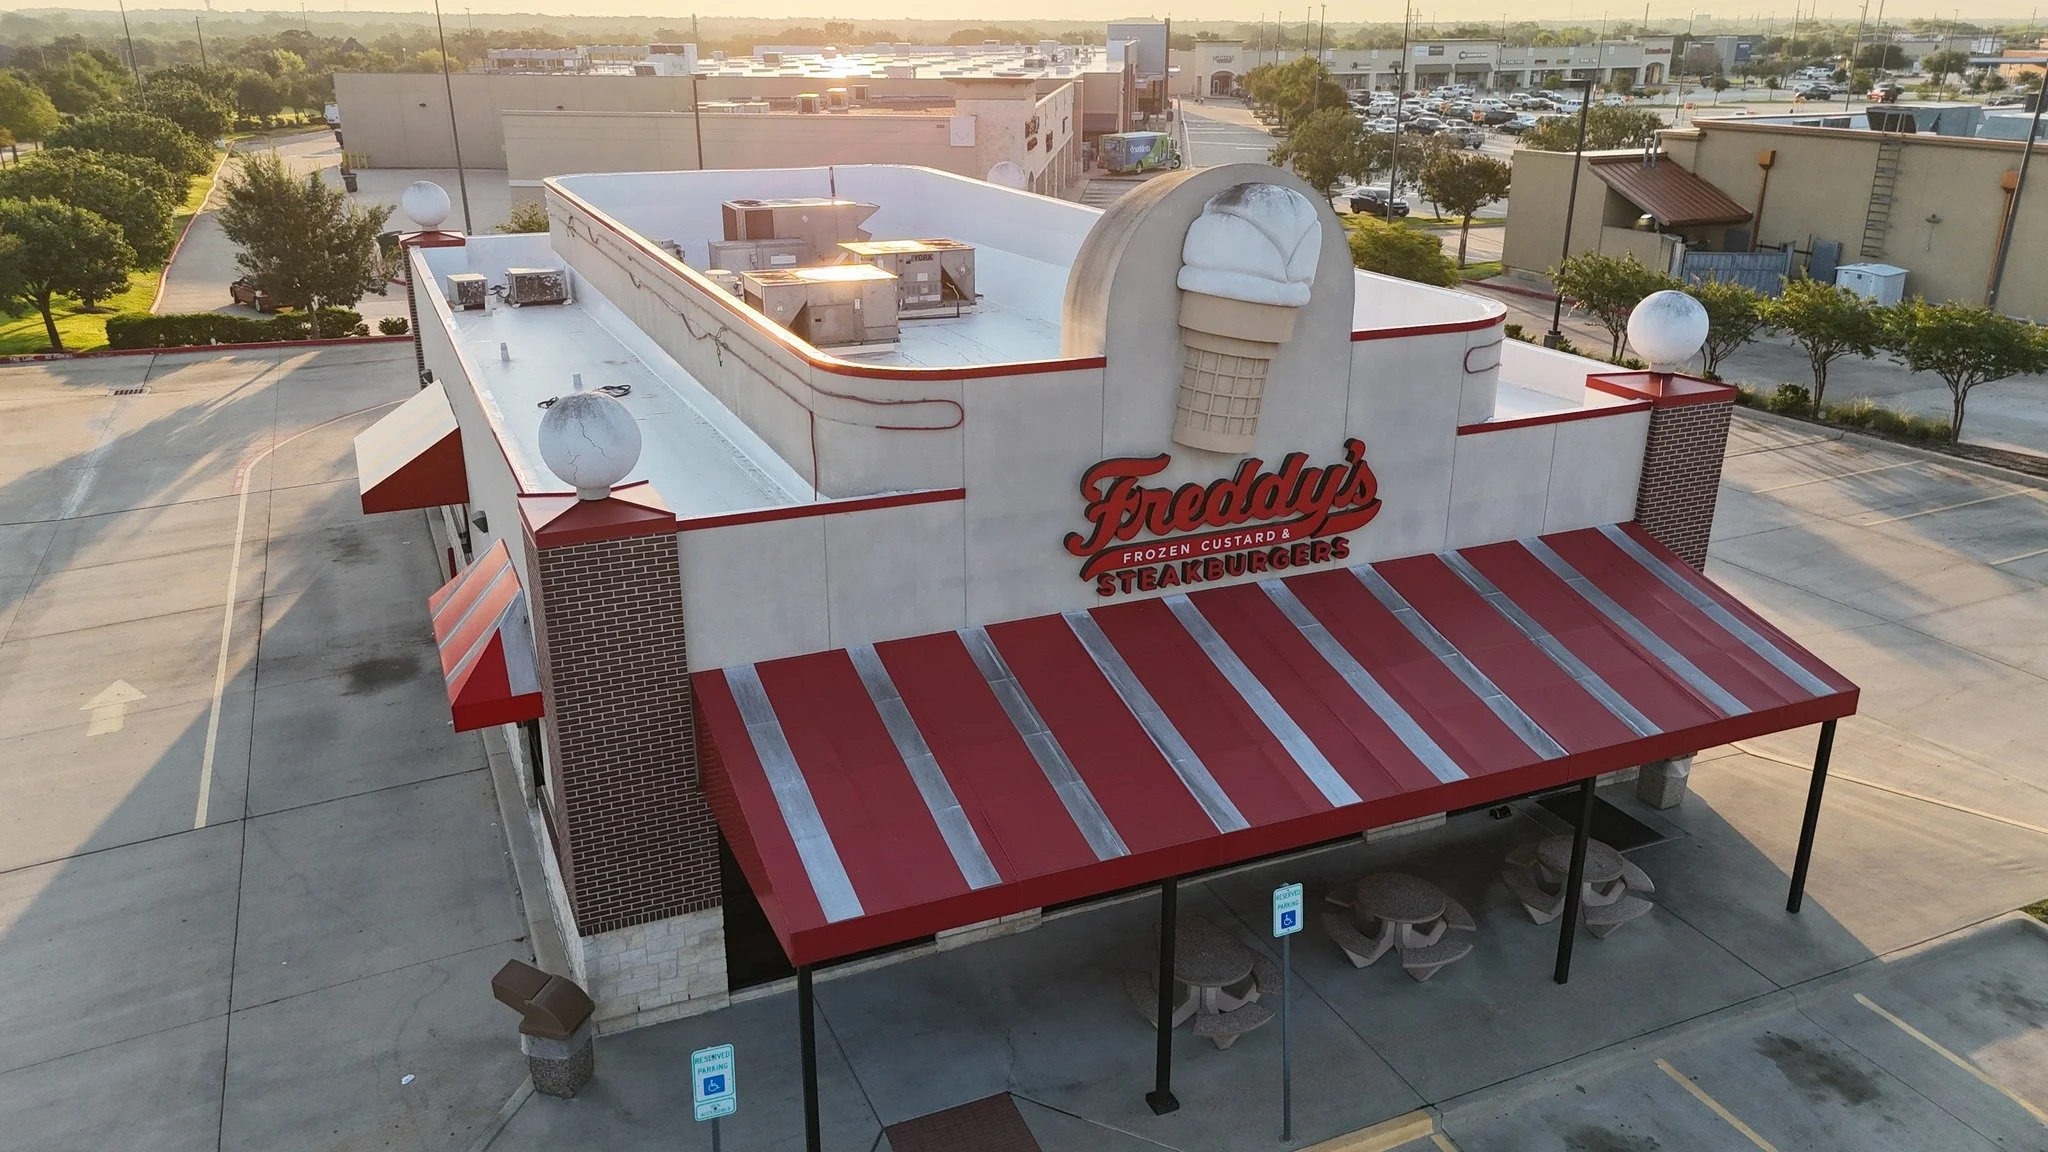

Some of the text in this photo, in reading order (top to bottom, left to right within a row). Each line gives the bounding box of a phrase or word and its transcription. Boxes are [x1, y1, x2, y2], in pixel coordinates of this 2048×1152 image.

[913, 253, 934, 262] YORK
[1063, 437, 1381, 567] Freddy's
[1123, 528, 1291, 564] FROZEN CUSTARD &
[1095, 536, 1350, 597] STEAKBURGERS
[1276, 889, 1301, 900] RESERVED
[1277, 900, 1300, 911] PARKING
[694, 1051, 731, 1065] RESERVED
[697, 1062, 728, 1075] PARKING
